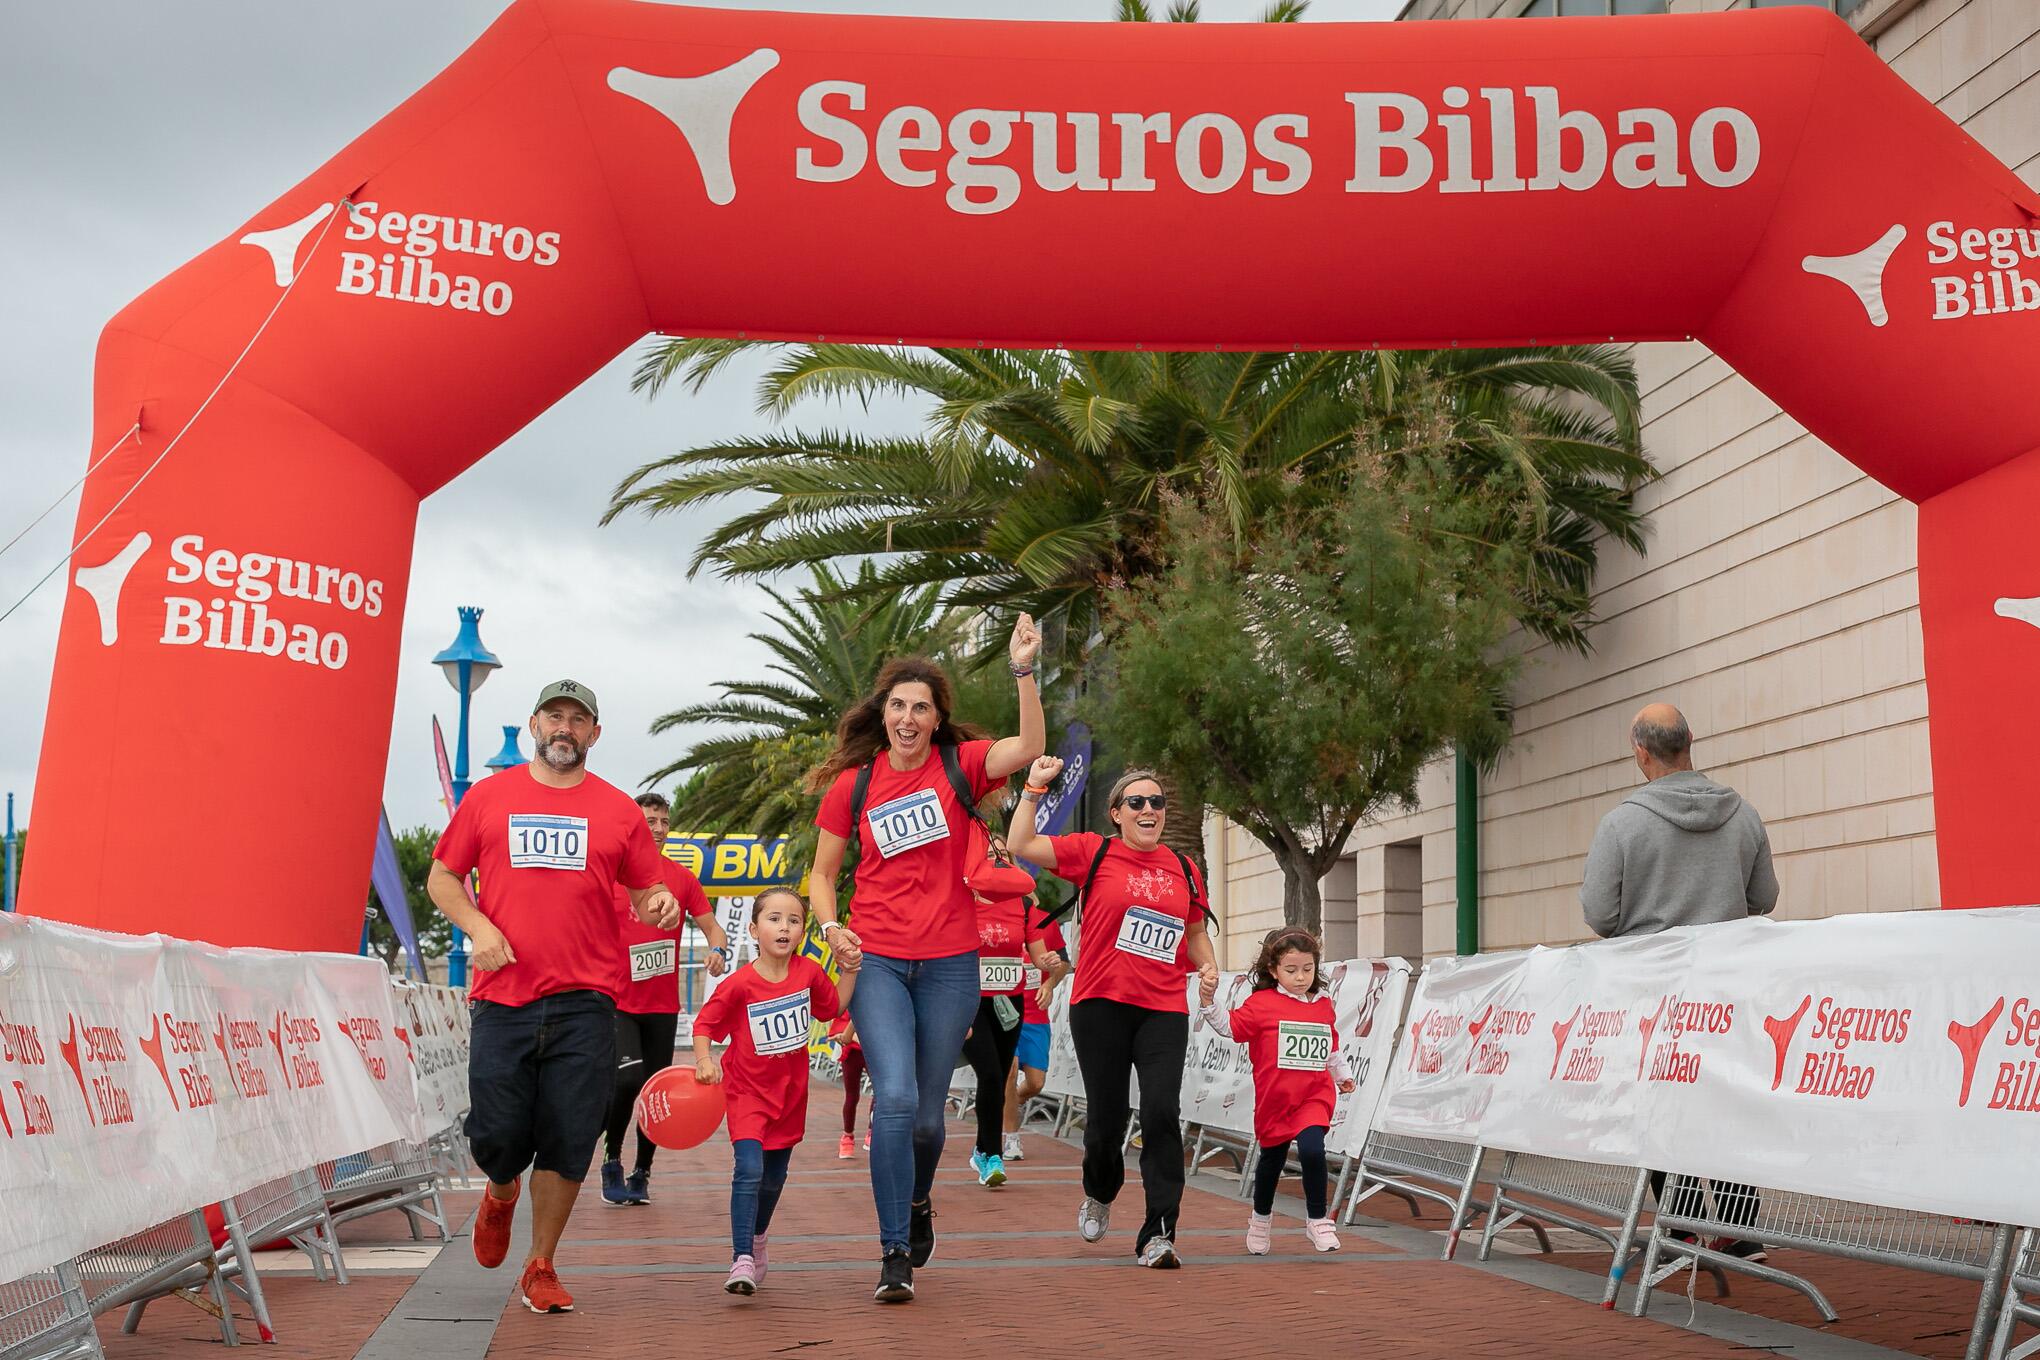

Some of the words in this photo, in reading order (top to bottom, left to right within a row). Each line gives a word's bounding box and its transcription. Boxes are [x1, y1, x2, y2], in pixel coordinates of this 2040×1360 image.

[797, 81, 1311, 214] Seguros
[1345, 87, 1760, 193] Bilbao
[345, 202, 560, 265] Seguros
[336, 252, 512, 315] Bilbao
[167, 535, 382, 616] Seguros
[160, 597, 347, 669] Bilbao
[518, 829, 578, 856] 1010
[879, 804, 936, 842] 1010
[1131, 920, 1176, 950] 1010
[636, 949, 668, 971] 2001
[985, 966, 1018, 982] 2001
[759, 1005, 808, 1041] 1010
[1577, 1004, 1627, 1045] Seguros
[1811, 997, 1911, 1049] Seguros
[1202, 1037, 1231, 1072] Getxo
[1285, 1036, 1329, 1060] 2028
[1562, 1048, 1605, 1082] Bilbao
[1649, 1042, 1701, 1083] Bilbao
[1795, 1051, 1875, 1100] Bilbao
